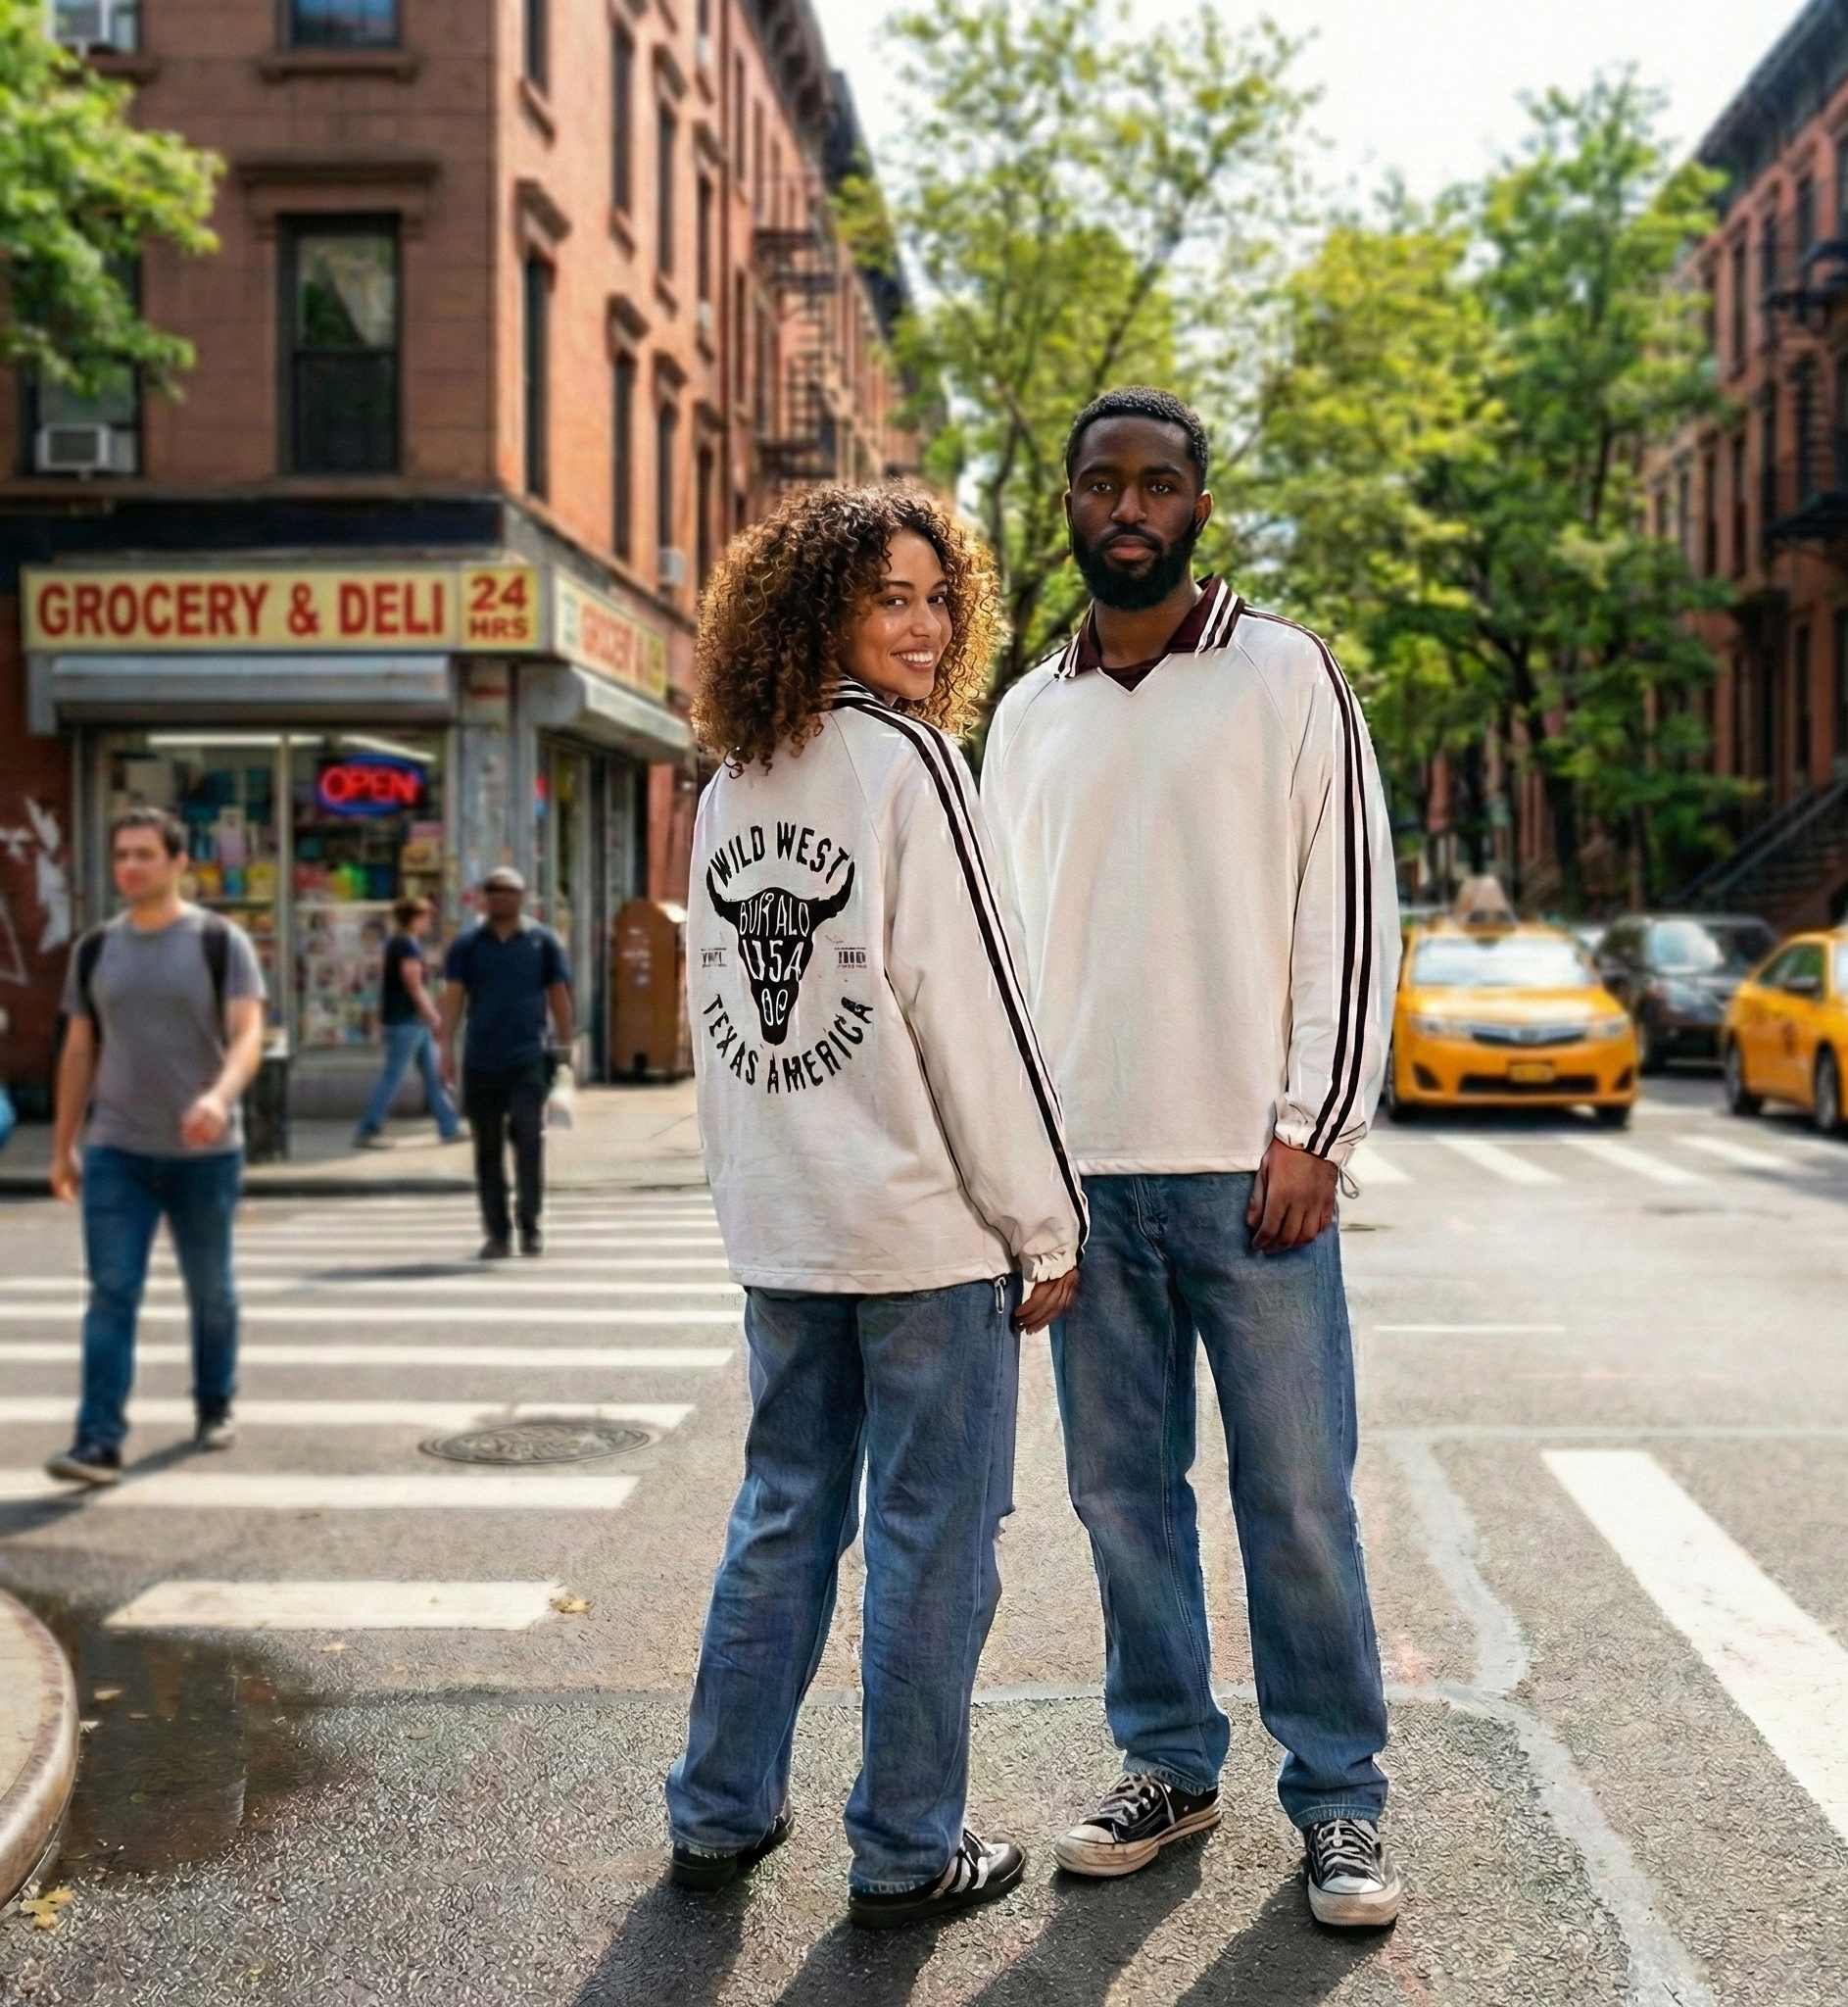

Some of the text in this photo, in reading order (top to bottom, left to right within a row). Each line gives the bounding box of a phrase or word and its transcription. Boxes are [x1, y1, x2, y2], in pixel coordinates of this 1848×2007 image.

[36, 581, 446, 639] GROCERY & DELI
[468, 575, 529, 612] 24
[468, 616, 529, 641] HRS
[320, 766, 418, 804] OPEN
[710, 821, 851, 888] WILD WEST
[703, 994, 874, 1094] TEXAS AMERICA
